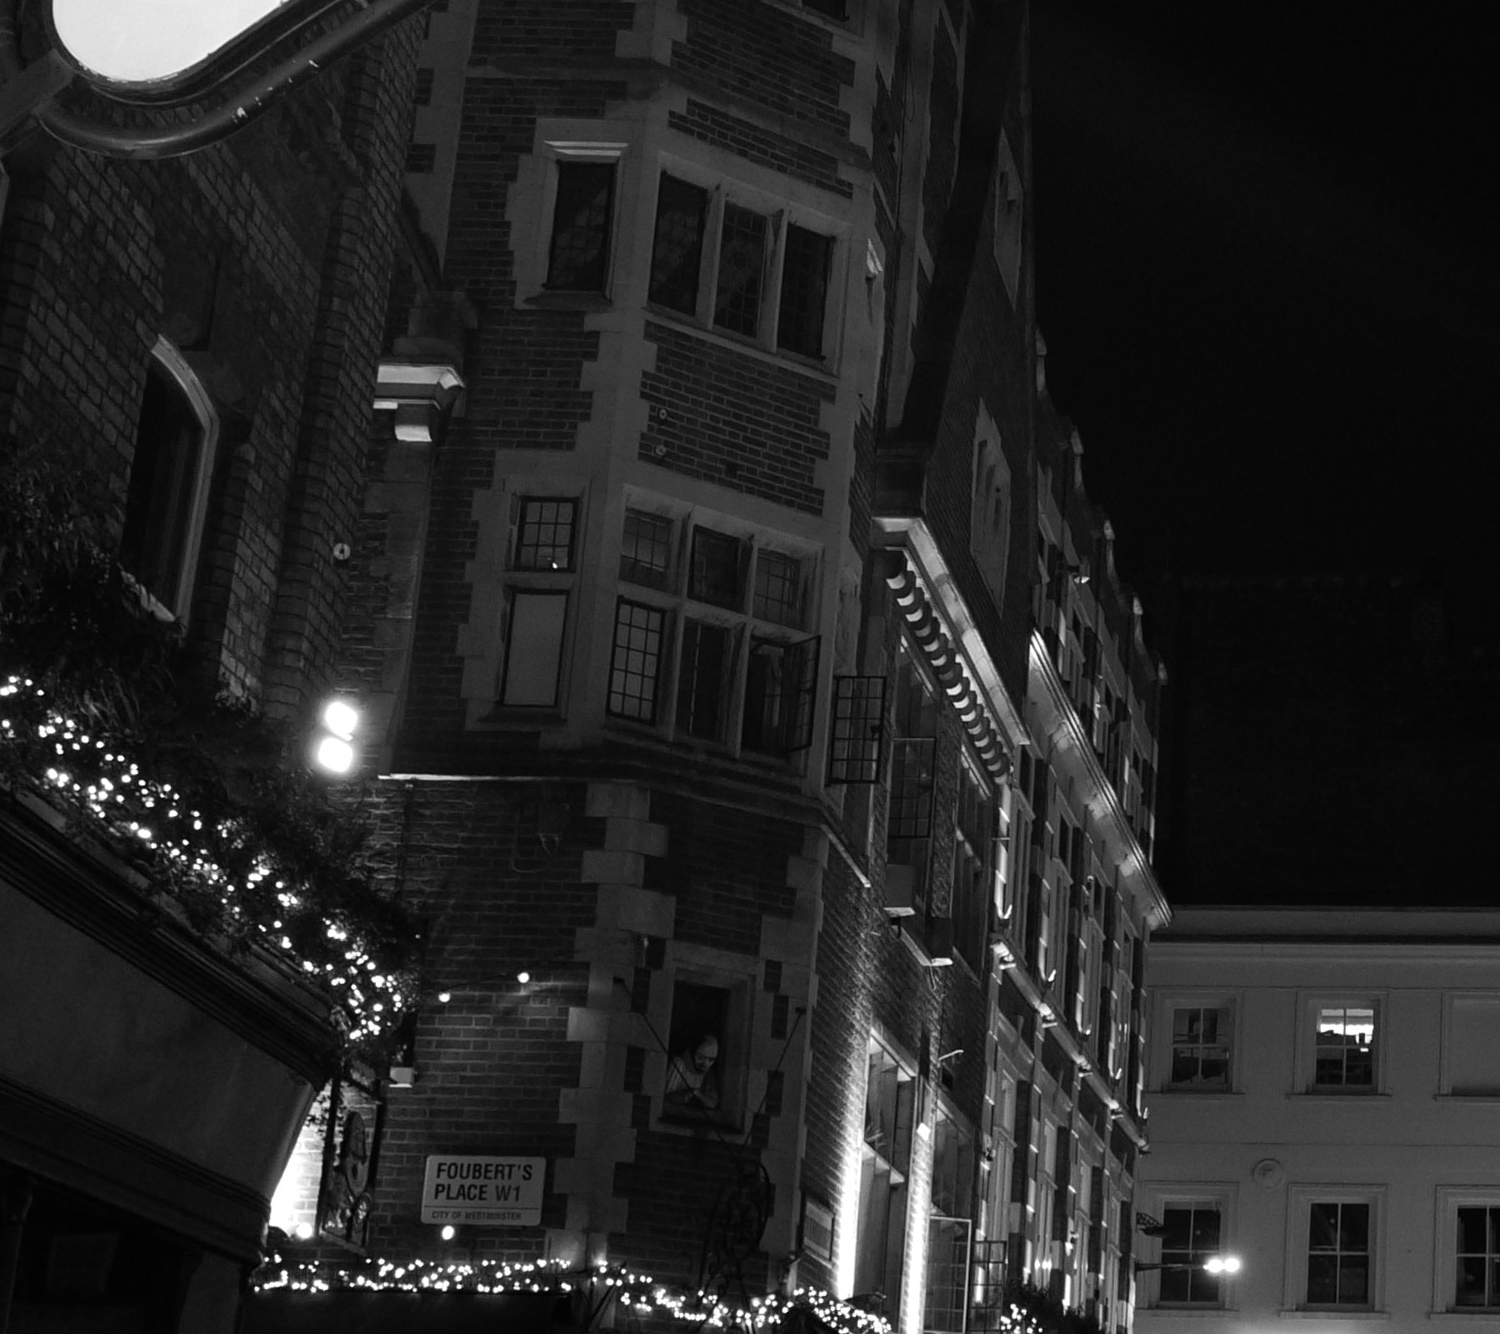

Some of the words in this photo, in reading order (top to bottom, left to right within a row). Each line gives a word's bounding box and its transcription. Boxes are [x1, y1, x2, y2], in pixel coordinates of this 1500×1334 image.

[436, 1162, 532, 1181] FOUBERT'S
[434, 1183, 488, 1201] PLACE
[496, 1185, 520, 1202] W1
